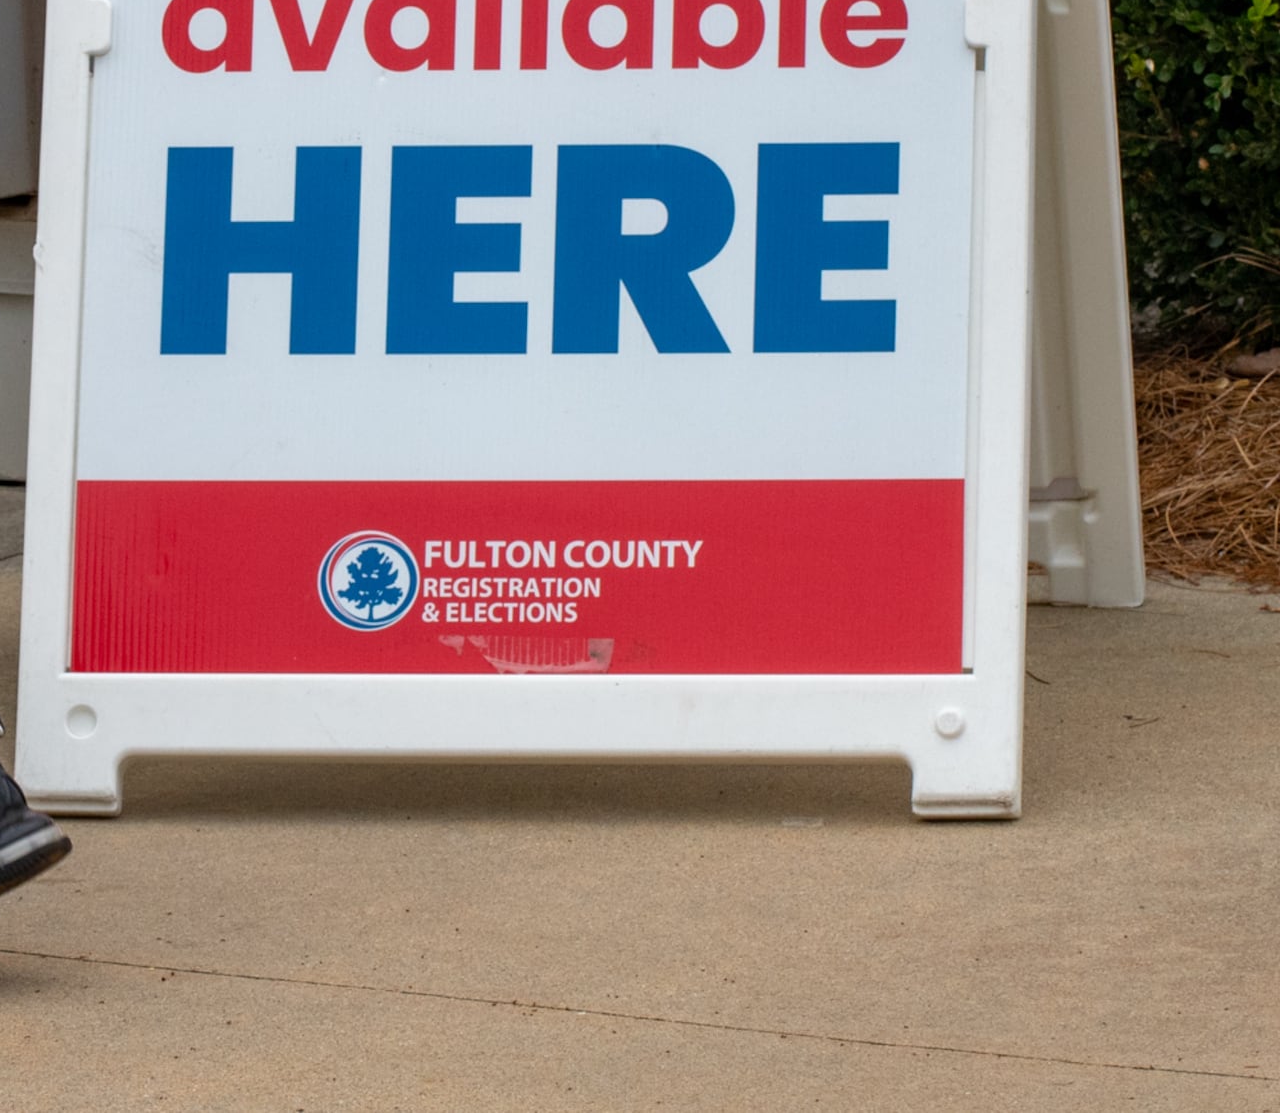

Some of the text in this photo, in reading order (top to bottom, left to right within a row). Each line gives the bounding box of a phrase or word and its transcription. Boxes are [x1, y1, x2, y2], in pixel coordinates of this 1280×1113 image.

[159, 141, 901, 356] HERE
[424, 539, 704, 569] FULTON COUNTY
[422, 576, 601, 598] REGISTRATION
[421, 601, 578, 623] & ELECTIONS
